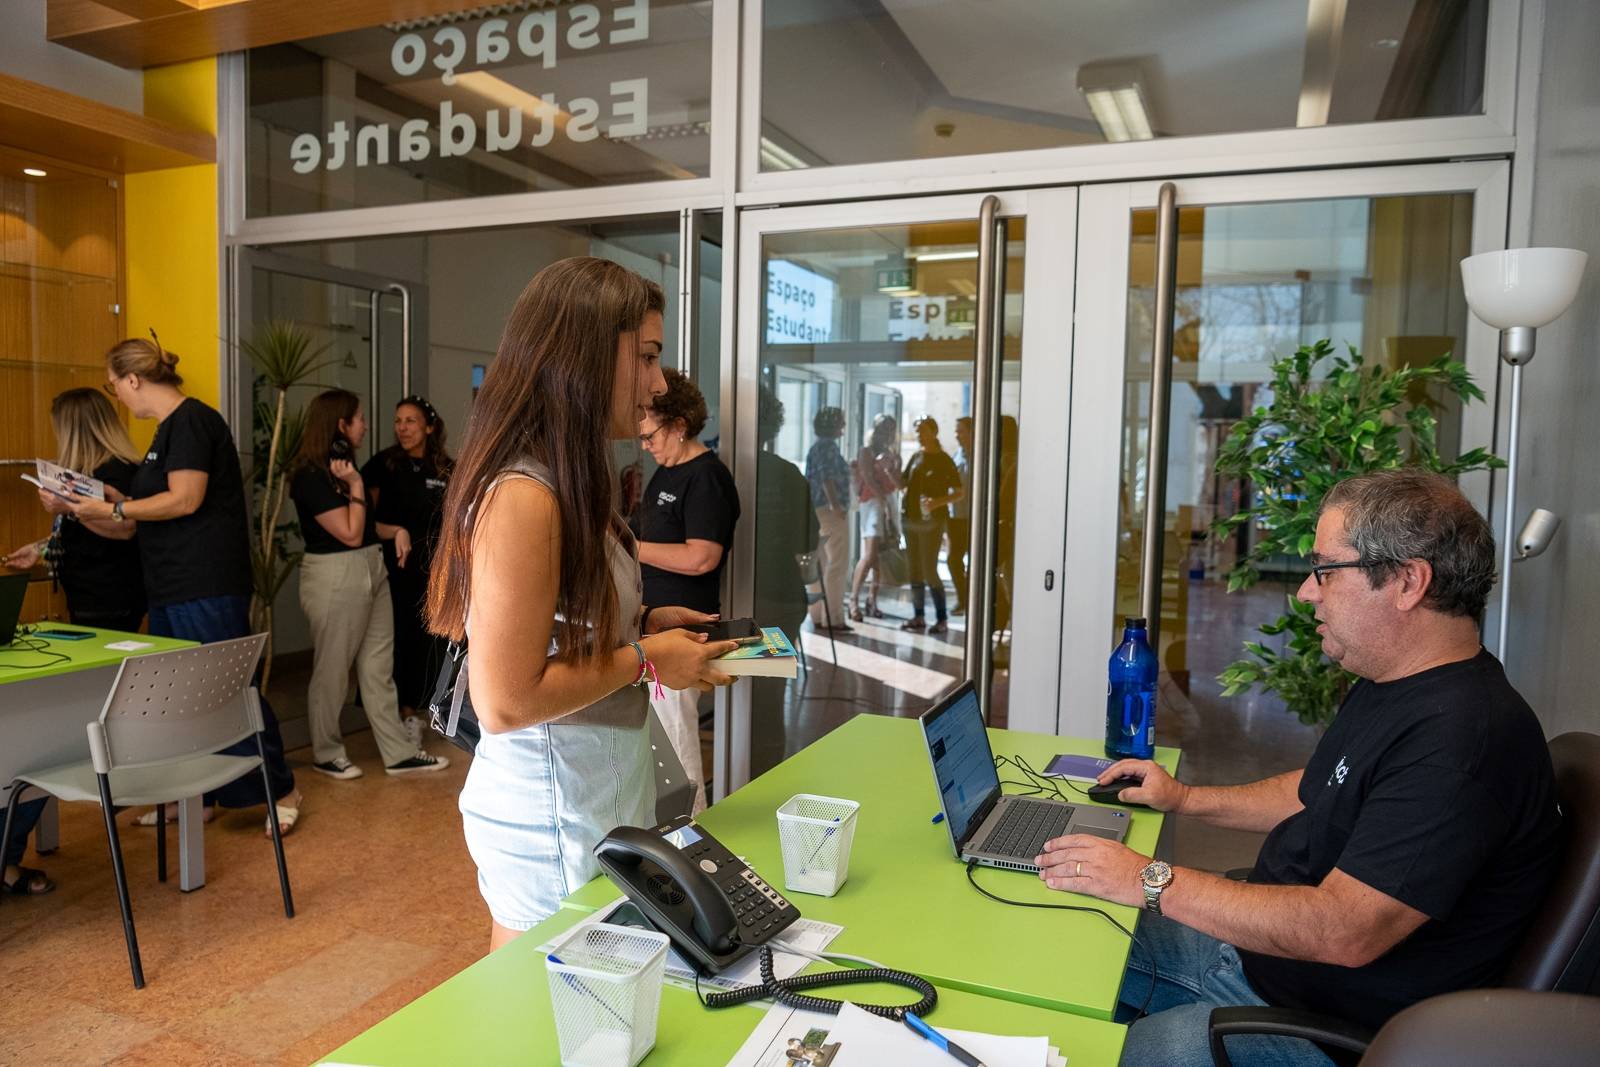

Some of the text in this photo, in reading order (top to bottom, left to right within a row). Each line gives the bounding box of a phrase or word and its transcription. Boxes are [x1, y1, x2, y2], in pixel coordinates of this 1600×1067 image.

[768, 272, 815, 311] Espaço
[768, 308, 833, 343] Estudant
[889, 301, 941, 324] Esp
